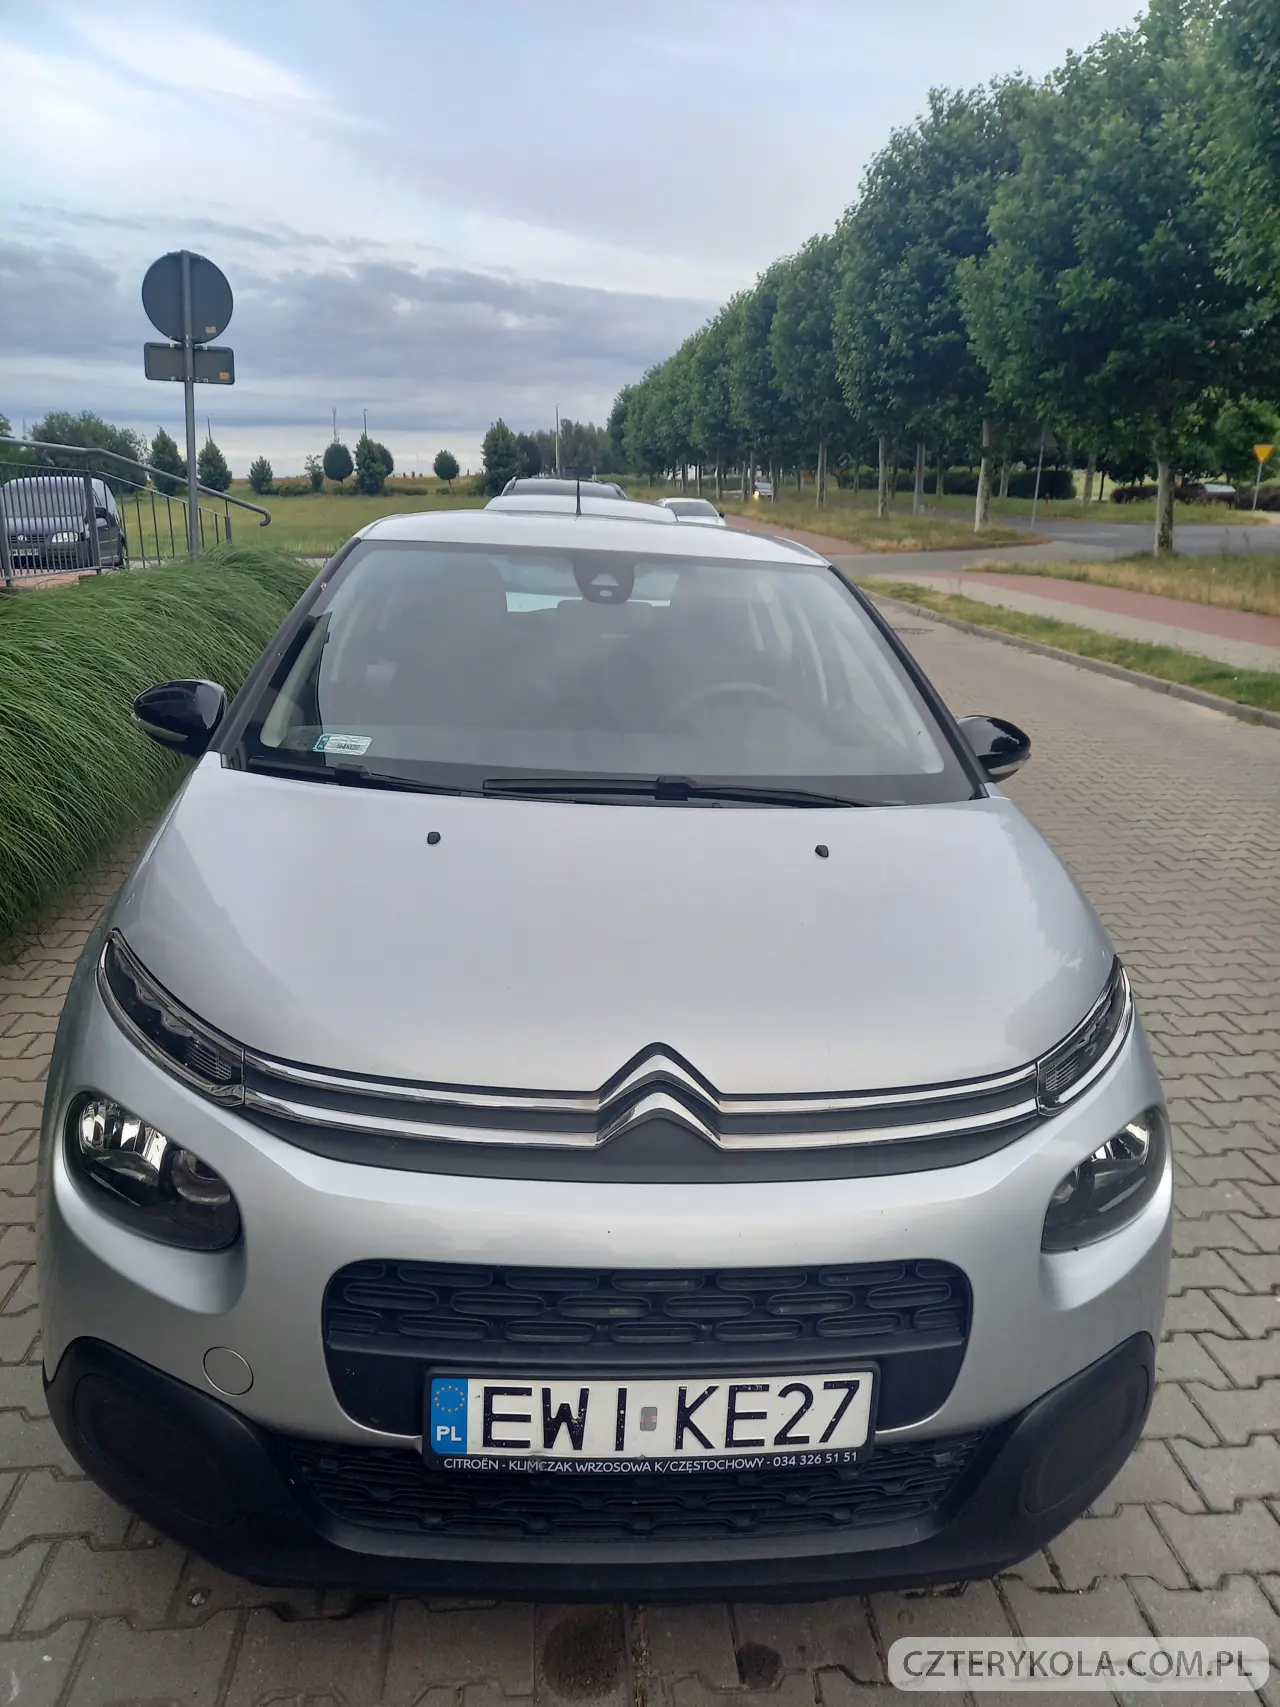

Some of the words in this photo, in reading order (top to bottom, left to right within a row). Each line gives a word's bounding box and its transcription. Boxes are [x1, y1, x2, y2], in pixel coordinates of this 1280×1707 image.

[482, 1385, 627, 1451] EWI
[674, 1379, 861, 1451] KE27
[436, 1425, 462, 1442] PL
[443, 1457, 499, 1470] CITROËN
[508, 1460, 573, 1473] KLIMCZAK
[575, 1461, 652, 1473] WRZOSOWA
[654, 1457, 765, 1474] K/CZĘSTOCHOWY
[773, 1456, 797, 1467] 034
[799, 1454, 822, 1466] 326
[825, 1452, 839, 1464] 51
[843, 1451, 857, 1462] 51
